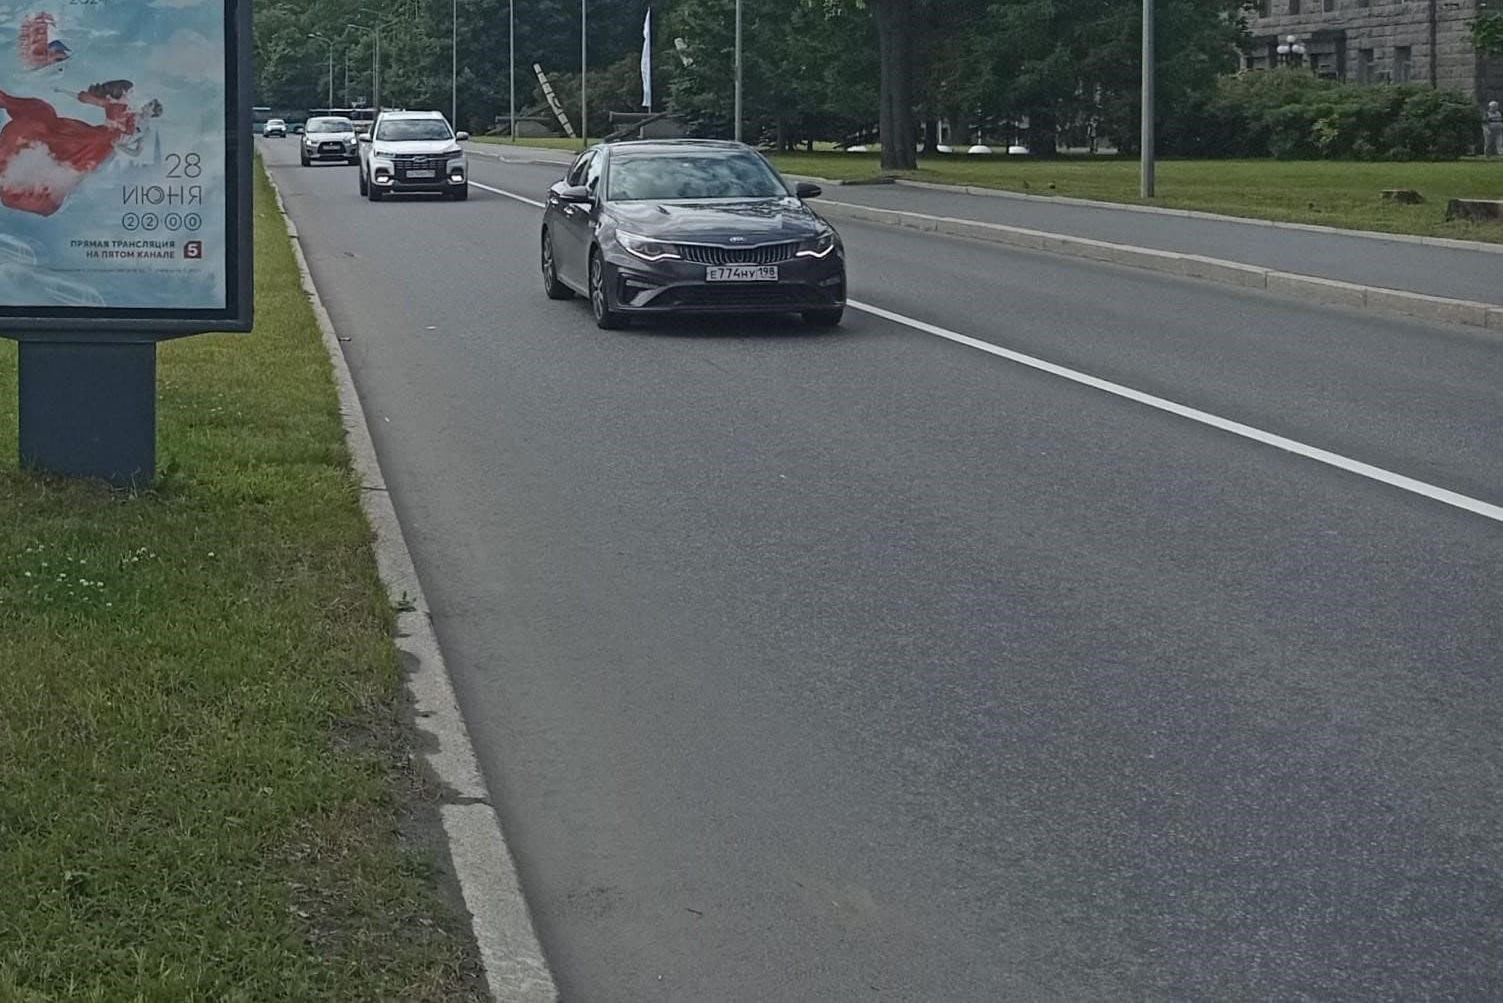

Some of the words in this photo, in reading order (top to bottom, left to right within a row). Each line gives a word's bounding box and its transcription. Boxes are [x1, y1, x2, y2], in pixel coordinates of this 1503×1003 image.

[164, 152, 202, 179] 28
[122, 185, 202, 206] ИЮНЯ
[70, 240, 110, 248] ПРЯМАЯ
[112, 240, 176, 249] ТРАНСЛЯЦИЯ
[86, 250, 100, 259] НА
[102, 250, 135, 259] ПЯТОМ
[137, 250, 175, 259] КАНАЛЕ
